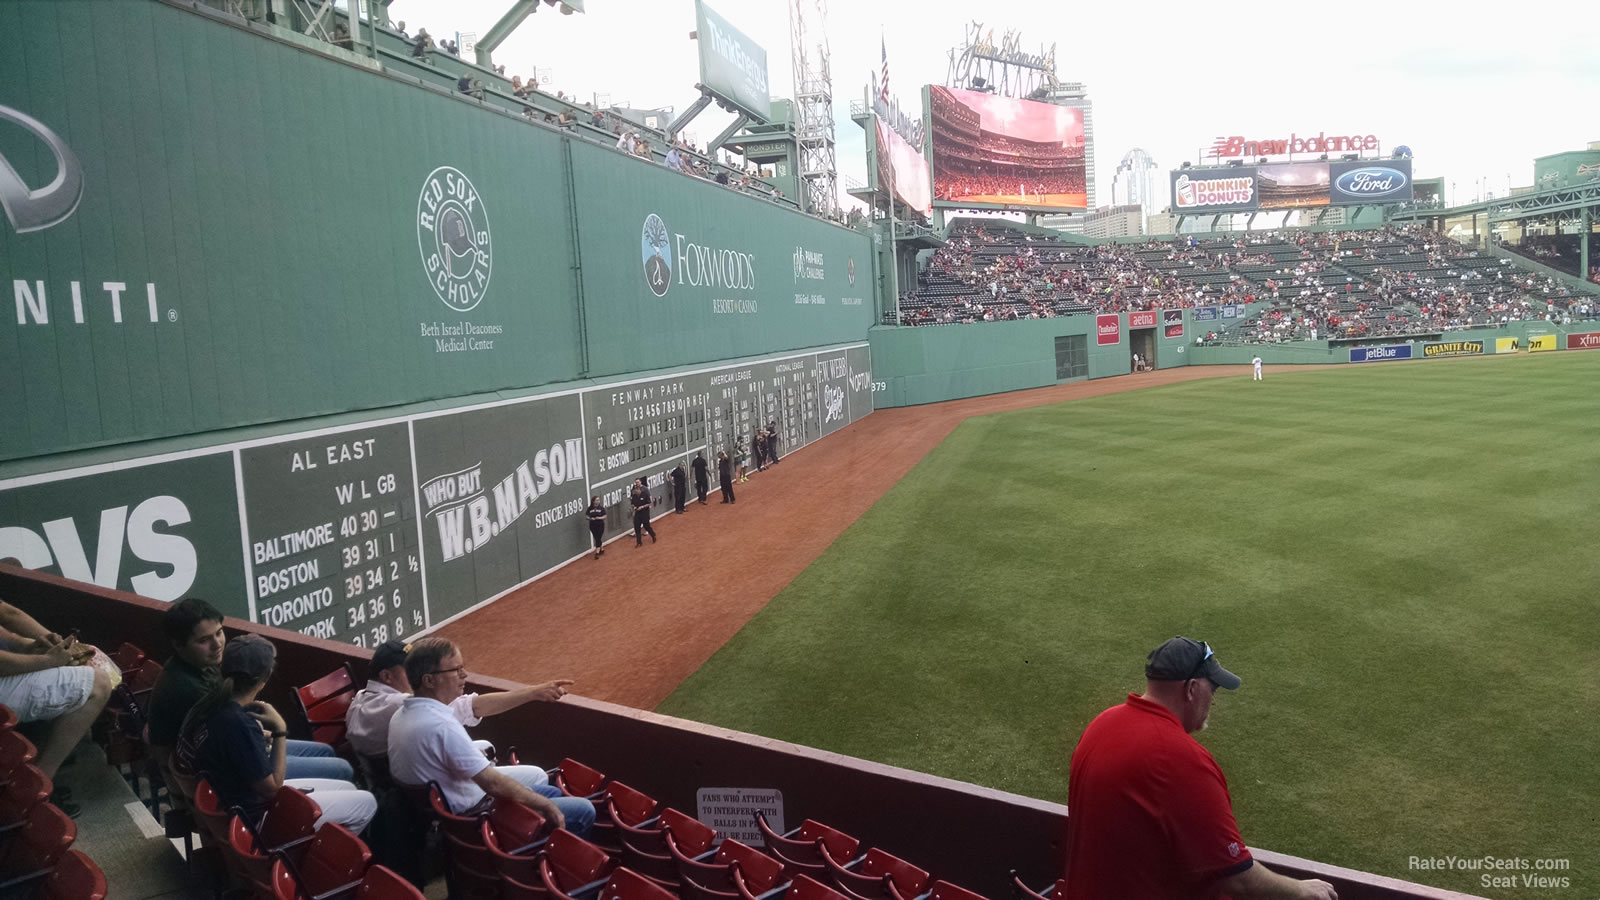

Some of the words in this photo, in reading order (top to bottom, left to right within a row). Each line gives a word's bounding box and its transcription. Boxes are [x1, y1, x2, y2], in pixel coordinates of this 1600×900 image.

[747, 143, 785, 152] MONSTER
[1245, 141, 1289, 156] new
[1291, 132, 1377, 153] balance
[1351, 172, 1393, 191] Ford
[420, 178, 443, 231] RED
[446, 173, 476, 213] SOX
[1198, 191, 1249, 204] DONUTS
[427, 231, 489, 304] SCHOLARS
[675, 233, 755, 290] FOXWOODS
[713, 299, 734, 313] RESORT
[739, 300, 757, 313] CASINO
[421, 321, 440, 337] Beth
[441, 321, 464, 336] Israel
[465, 321, 502, 335] Deaconess
[1133, 315, 1153, 326] aetna
[435, 338, 466, 352] Medical
[468, 337, 493, 350] Center
[1366, 345, 1397, 360] jetBlue
[1425, 342, 1462, 356] GRANITE
[1463, 341, 1483, 353] CITY
[711, 373, 734, 386] AMERICAN
[735, 370, 752, 382] LEAGUE
[612, 386, 654, 406] FENWAY
[660, 382, 684, 396] PARK
[291, 451, 317, 473] AL
[326, 439, 376, 465] EAST
[607, 450, 630, 470] BOSTON
[335, 483, 354, 506] W
[361, 480, 372, 500] L
[377, 474, 396, 495] GB
[423, 477, 456, 508] WHO
[457, 467, 482, 497] BUT
[603, 492, 611, 508] AT
[611, 488, 622, 505] BAT
[647, 471, 665, 489] STRIKE
[535, 508, 564, 529] SINCE
[564, 497, 583, 517] 1898
[253, 522, 335, 565] BALTIMORE
[340, 515, 357, 538] 40
[360, 509, 378, 532] 30
[257, 559, 319, 598] BOSTON
[343, 545, 361, 568] 39
[365, 538, 379, 560] 31
[261, 586, 333, 627] TORONTO
[345, 575, 363, 598] 39
[366, 566, 383, 590] 34
[390, 561, 400, 582] 2
[348, 603, 366, 627] 34
[369, 595, 386, 619] 36
[392, 588, 401, 609] 6
[371, 624, 388, 647] 38
[395, 617, 404, 636] 8
[702, 794, 721, 803] FANS
[723, 795, 740, 803] WHO
[741, 795, 776, 804] ATTEMPT
[702, 807, 712, 815] TO
[714, 819, 737, 828] BALLS
[739, 819, 748, 828] IN
